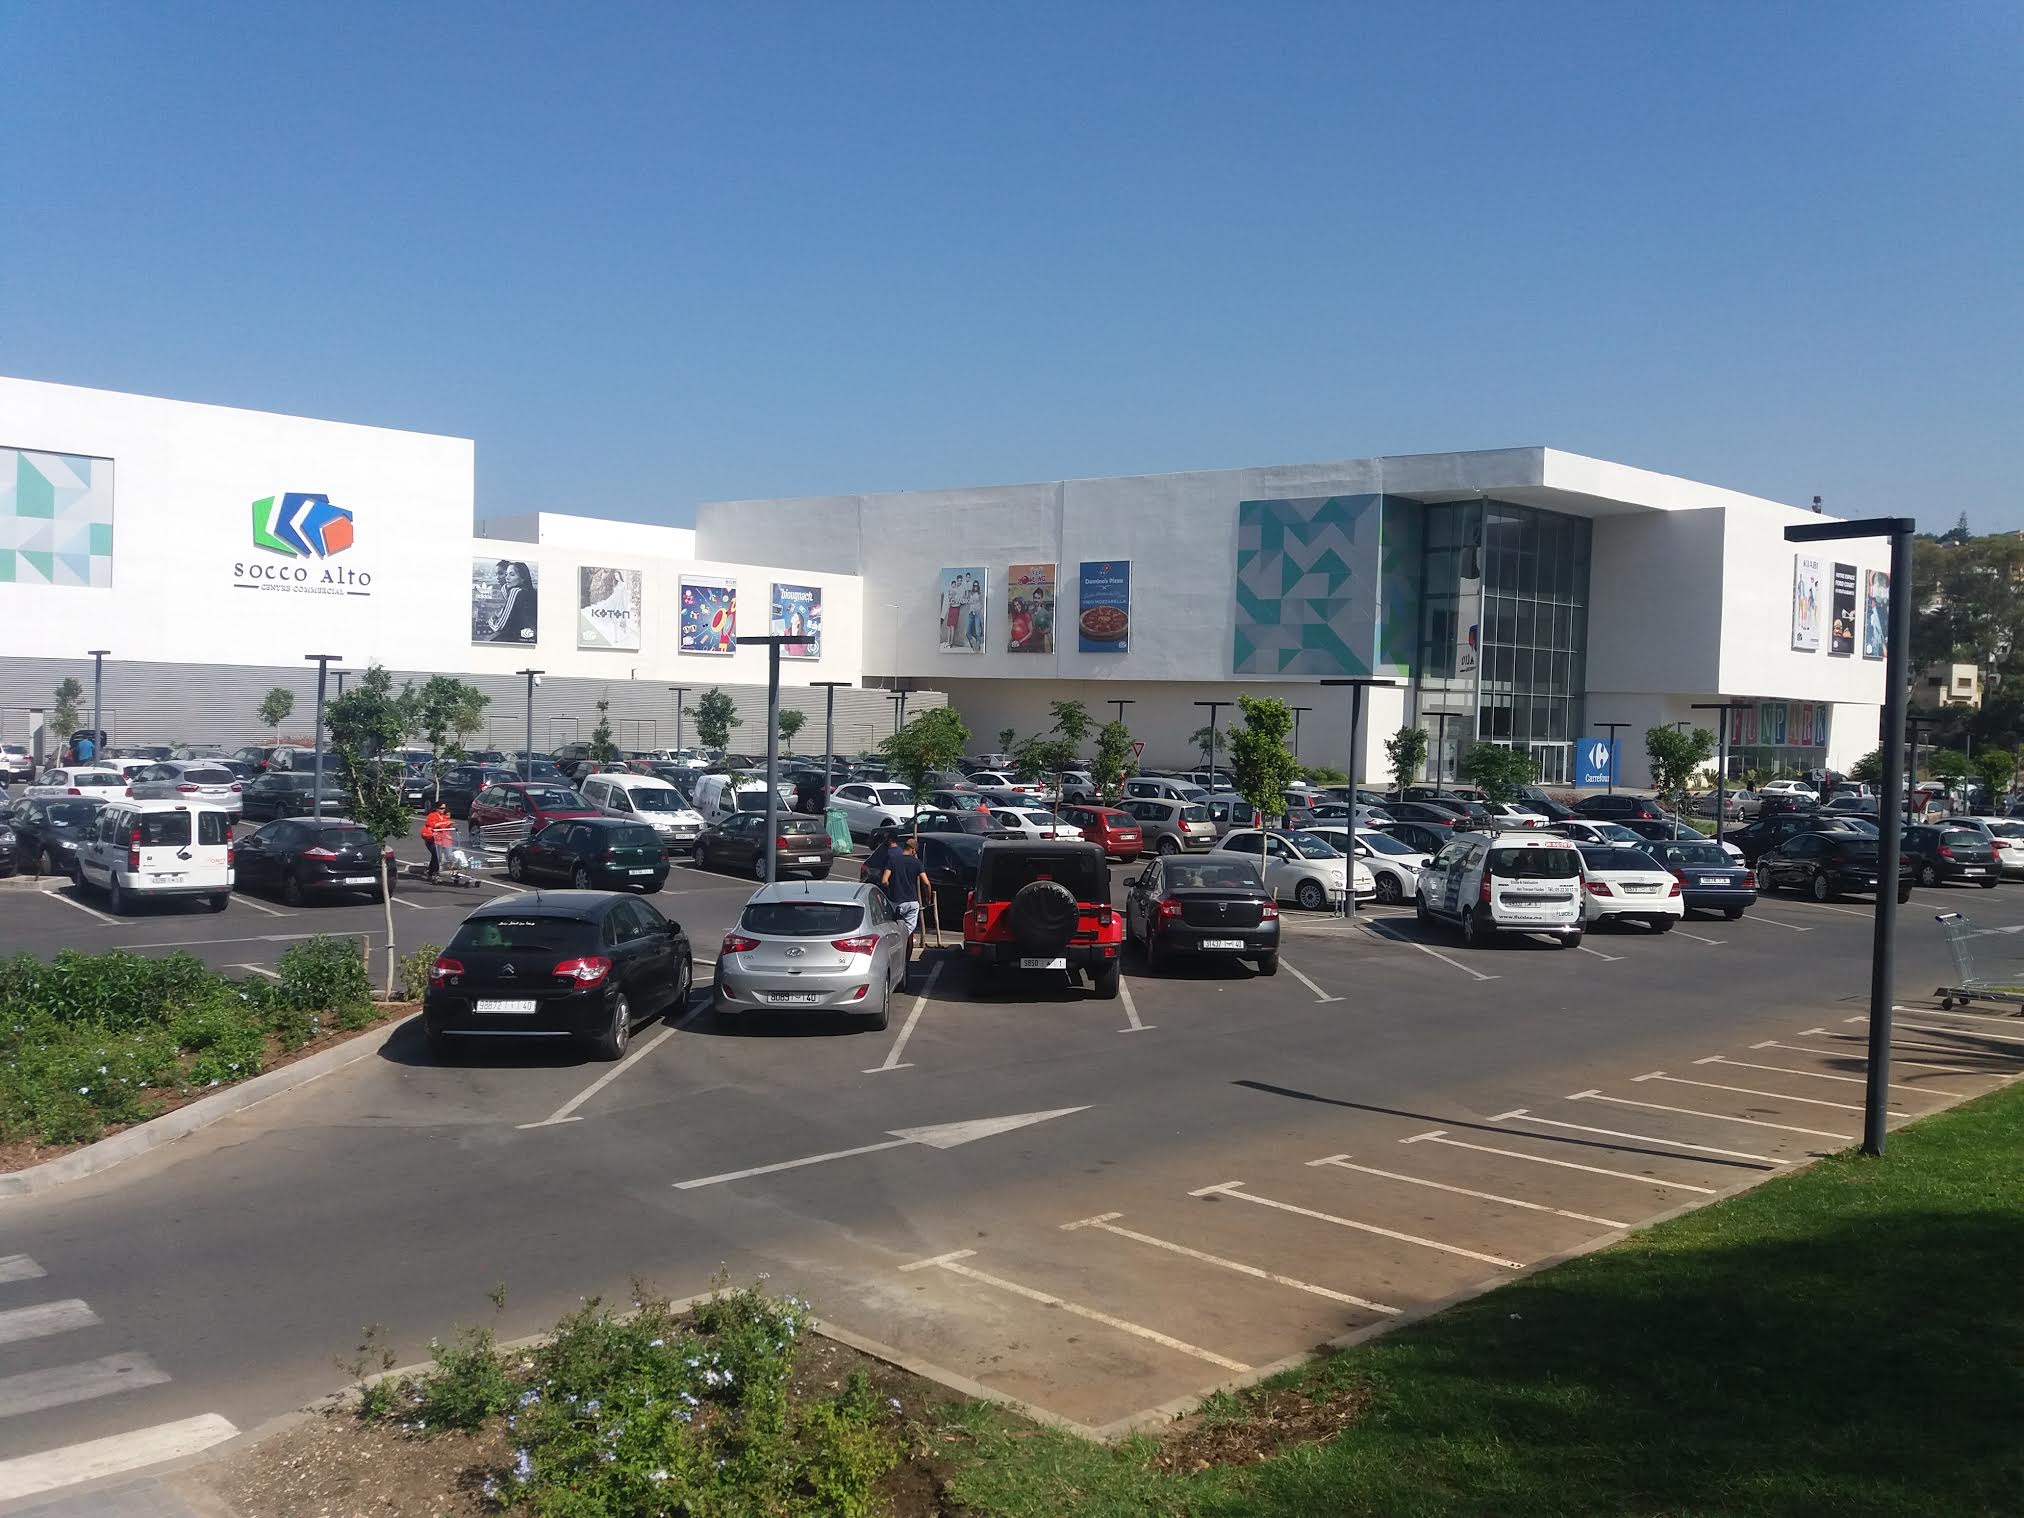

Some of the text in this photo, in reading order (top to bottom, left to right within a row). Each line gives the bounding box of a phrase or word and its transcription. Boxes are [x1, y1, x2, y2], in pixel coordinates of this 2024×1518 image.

[320, 566, 372, 586] Alto
[260, 583, 345, 596] CENTRE COMMERCIAL
[1585, 773, 1610, 783] Carrefou
